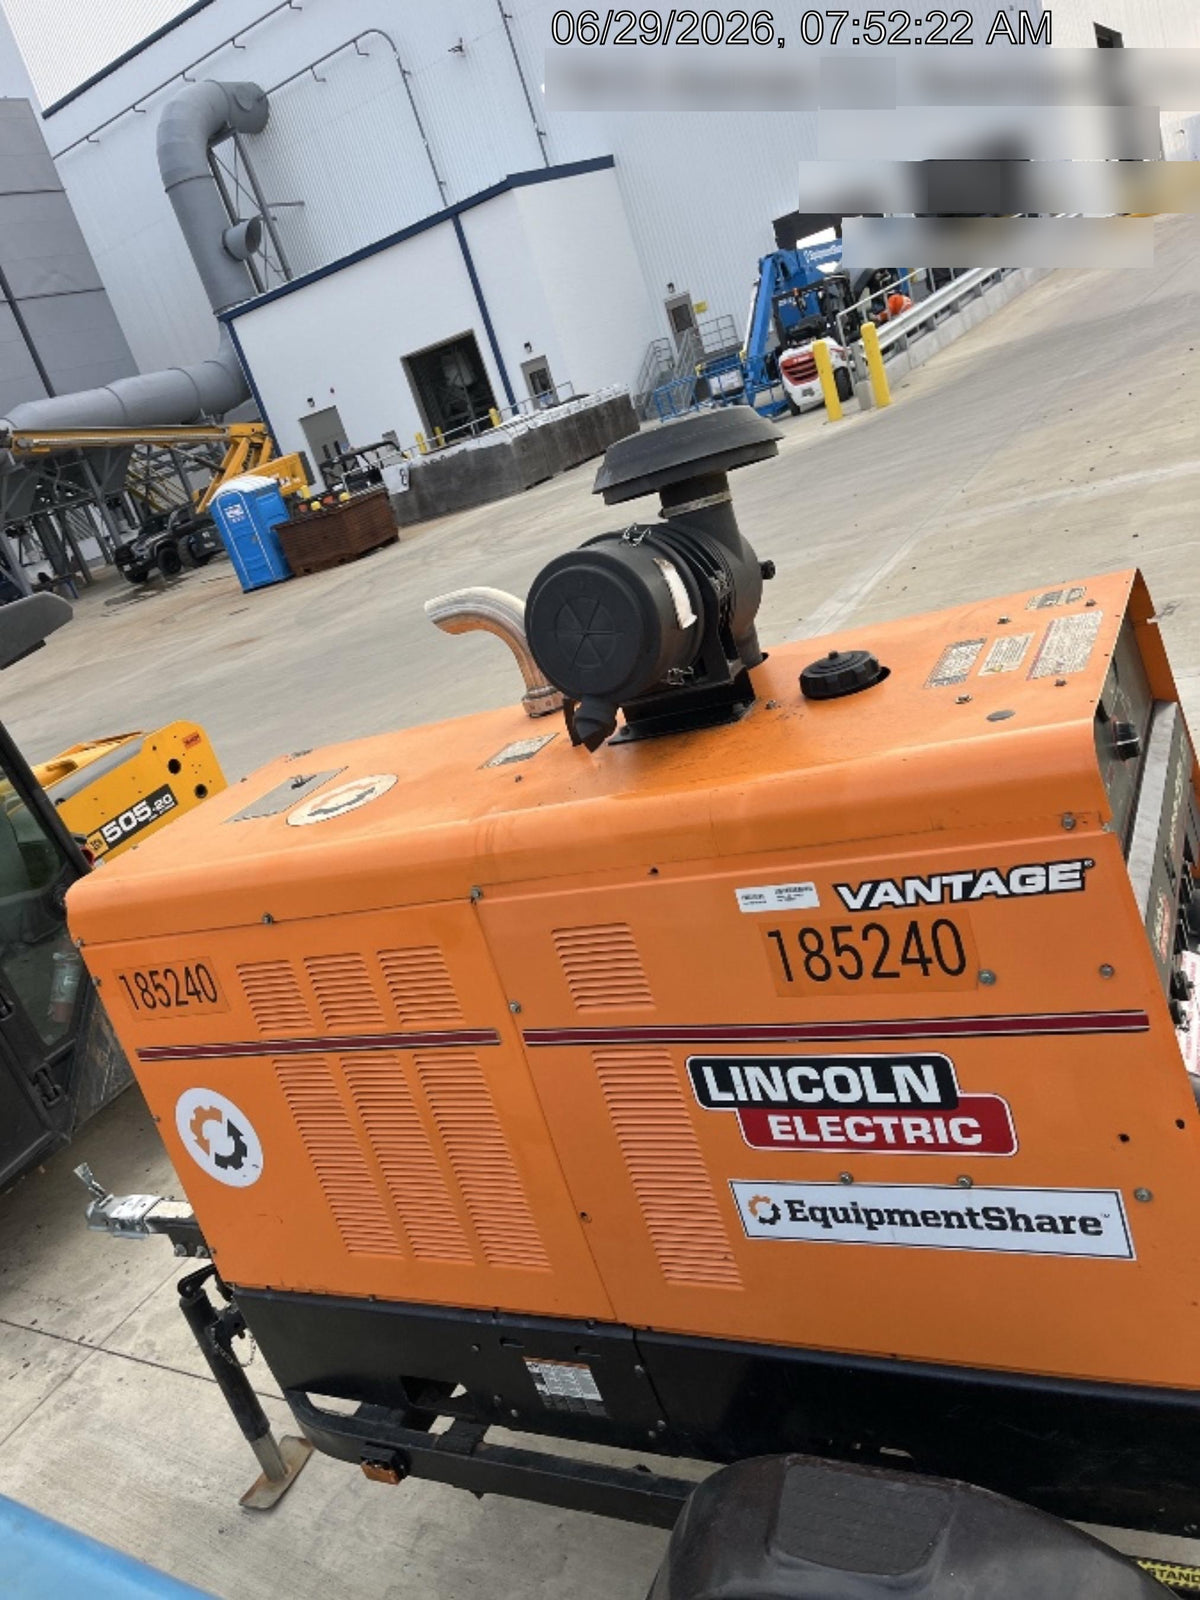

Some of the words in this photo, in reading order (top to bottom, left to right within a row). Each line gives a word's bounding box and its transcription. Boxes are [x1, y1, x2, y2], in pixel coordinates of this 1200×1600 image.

[767, 918, 967, 982] 185240
[119, 963, 218, 1010] 185240
[702, 1064, 941, 1103] LINCOLN
[767, 1114, 983, 1145] ELECTRIC
[784, 1199, 1104, 1236] EquipmentShare
